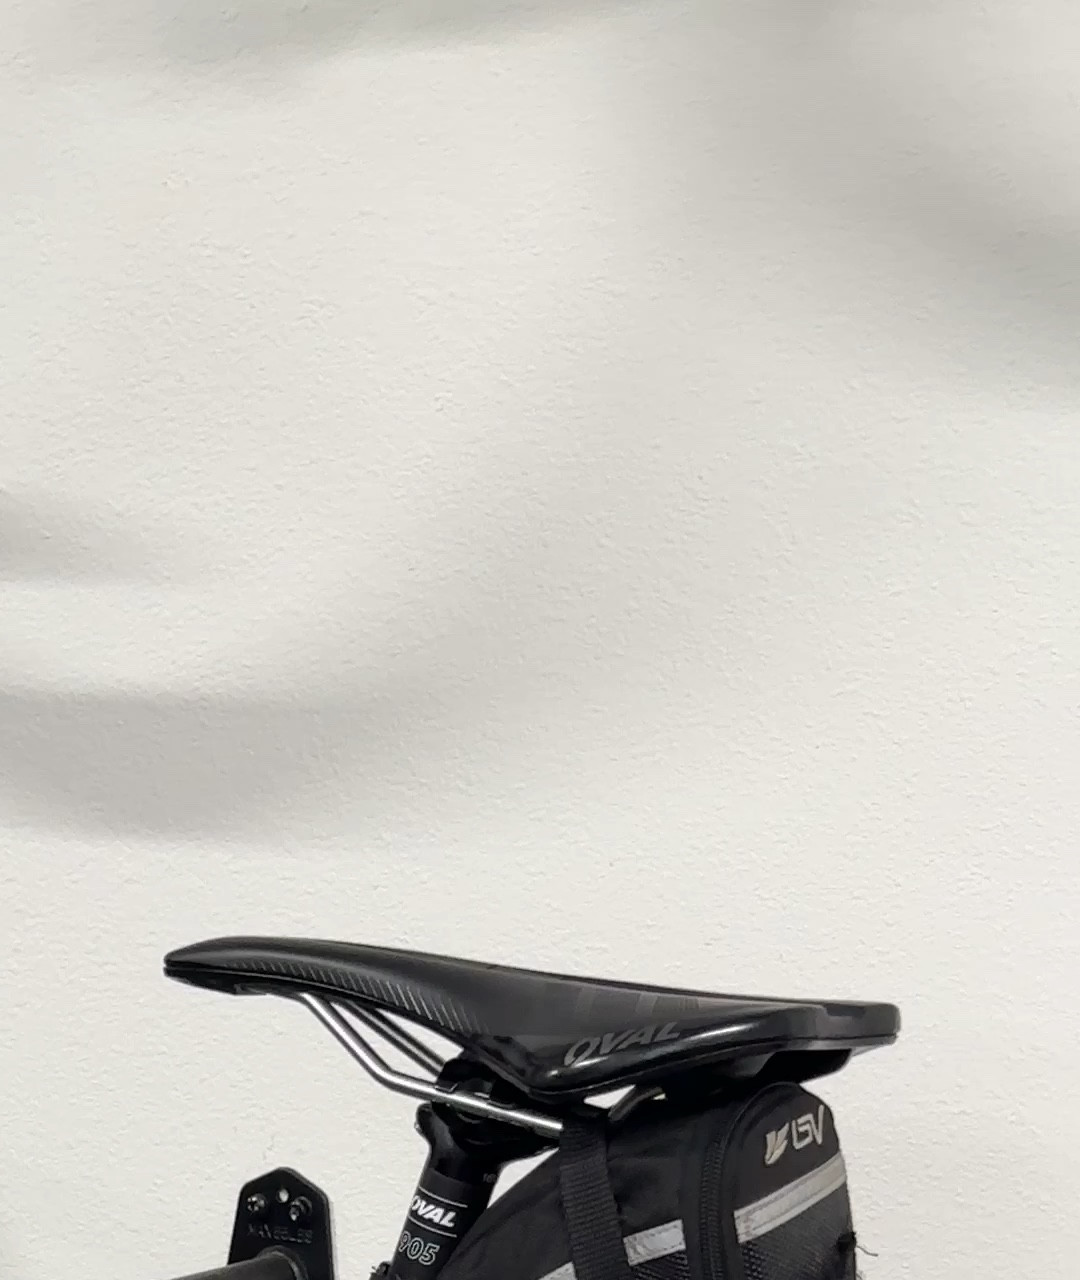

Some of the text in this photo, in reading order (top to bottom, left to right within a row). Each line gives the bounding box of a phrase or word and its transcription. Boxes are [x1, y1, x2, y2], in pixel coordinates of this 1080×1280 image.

[563, 1021, 682, 1067] OVAL
[411, 1195, 457, 1228] OVAL
[398, 1230, 440, 1266] 905
